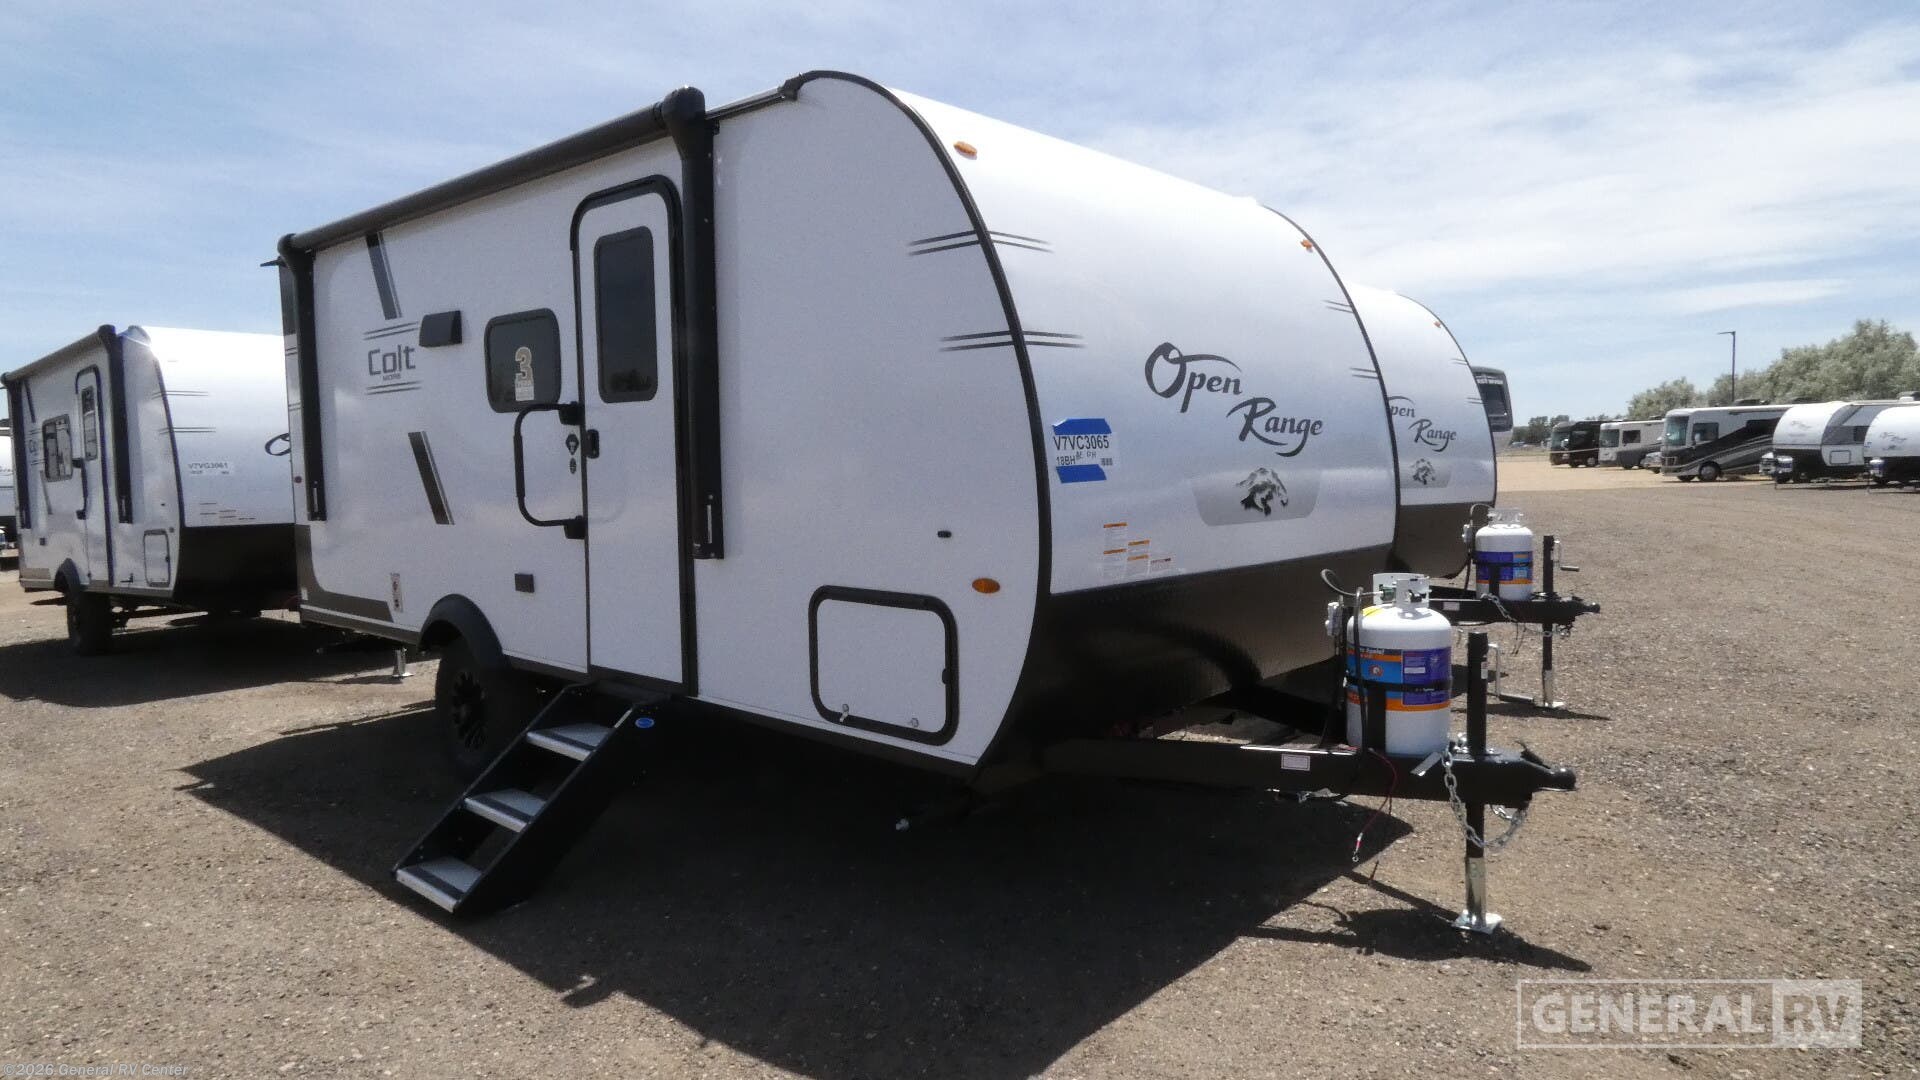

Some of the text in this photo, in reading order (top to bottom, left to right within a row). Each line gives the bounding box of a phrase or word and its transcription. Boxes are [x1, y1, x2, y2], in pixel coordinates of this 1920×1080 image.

[368, 344, 416, 376] Colt
[515, 346, 533, 384] 3
[1145, 342, 1242, 413] Open
[1388, 396, 1415, 418] pen
[1053, 435, 1110, 451] V7VC3065
[1226, 397, 1323, 458] Range
[1408, 419, 1457, 452] Range
